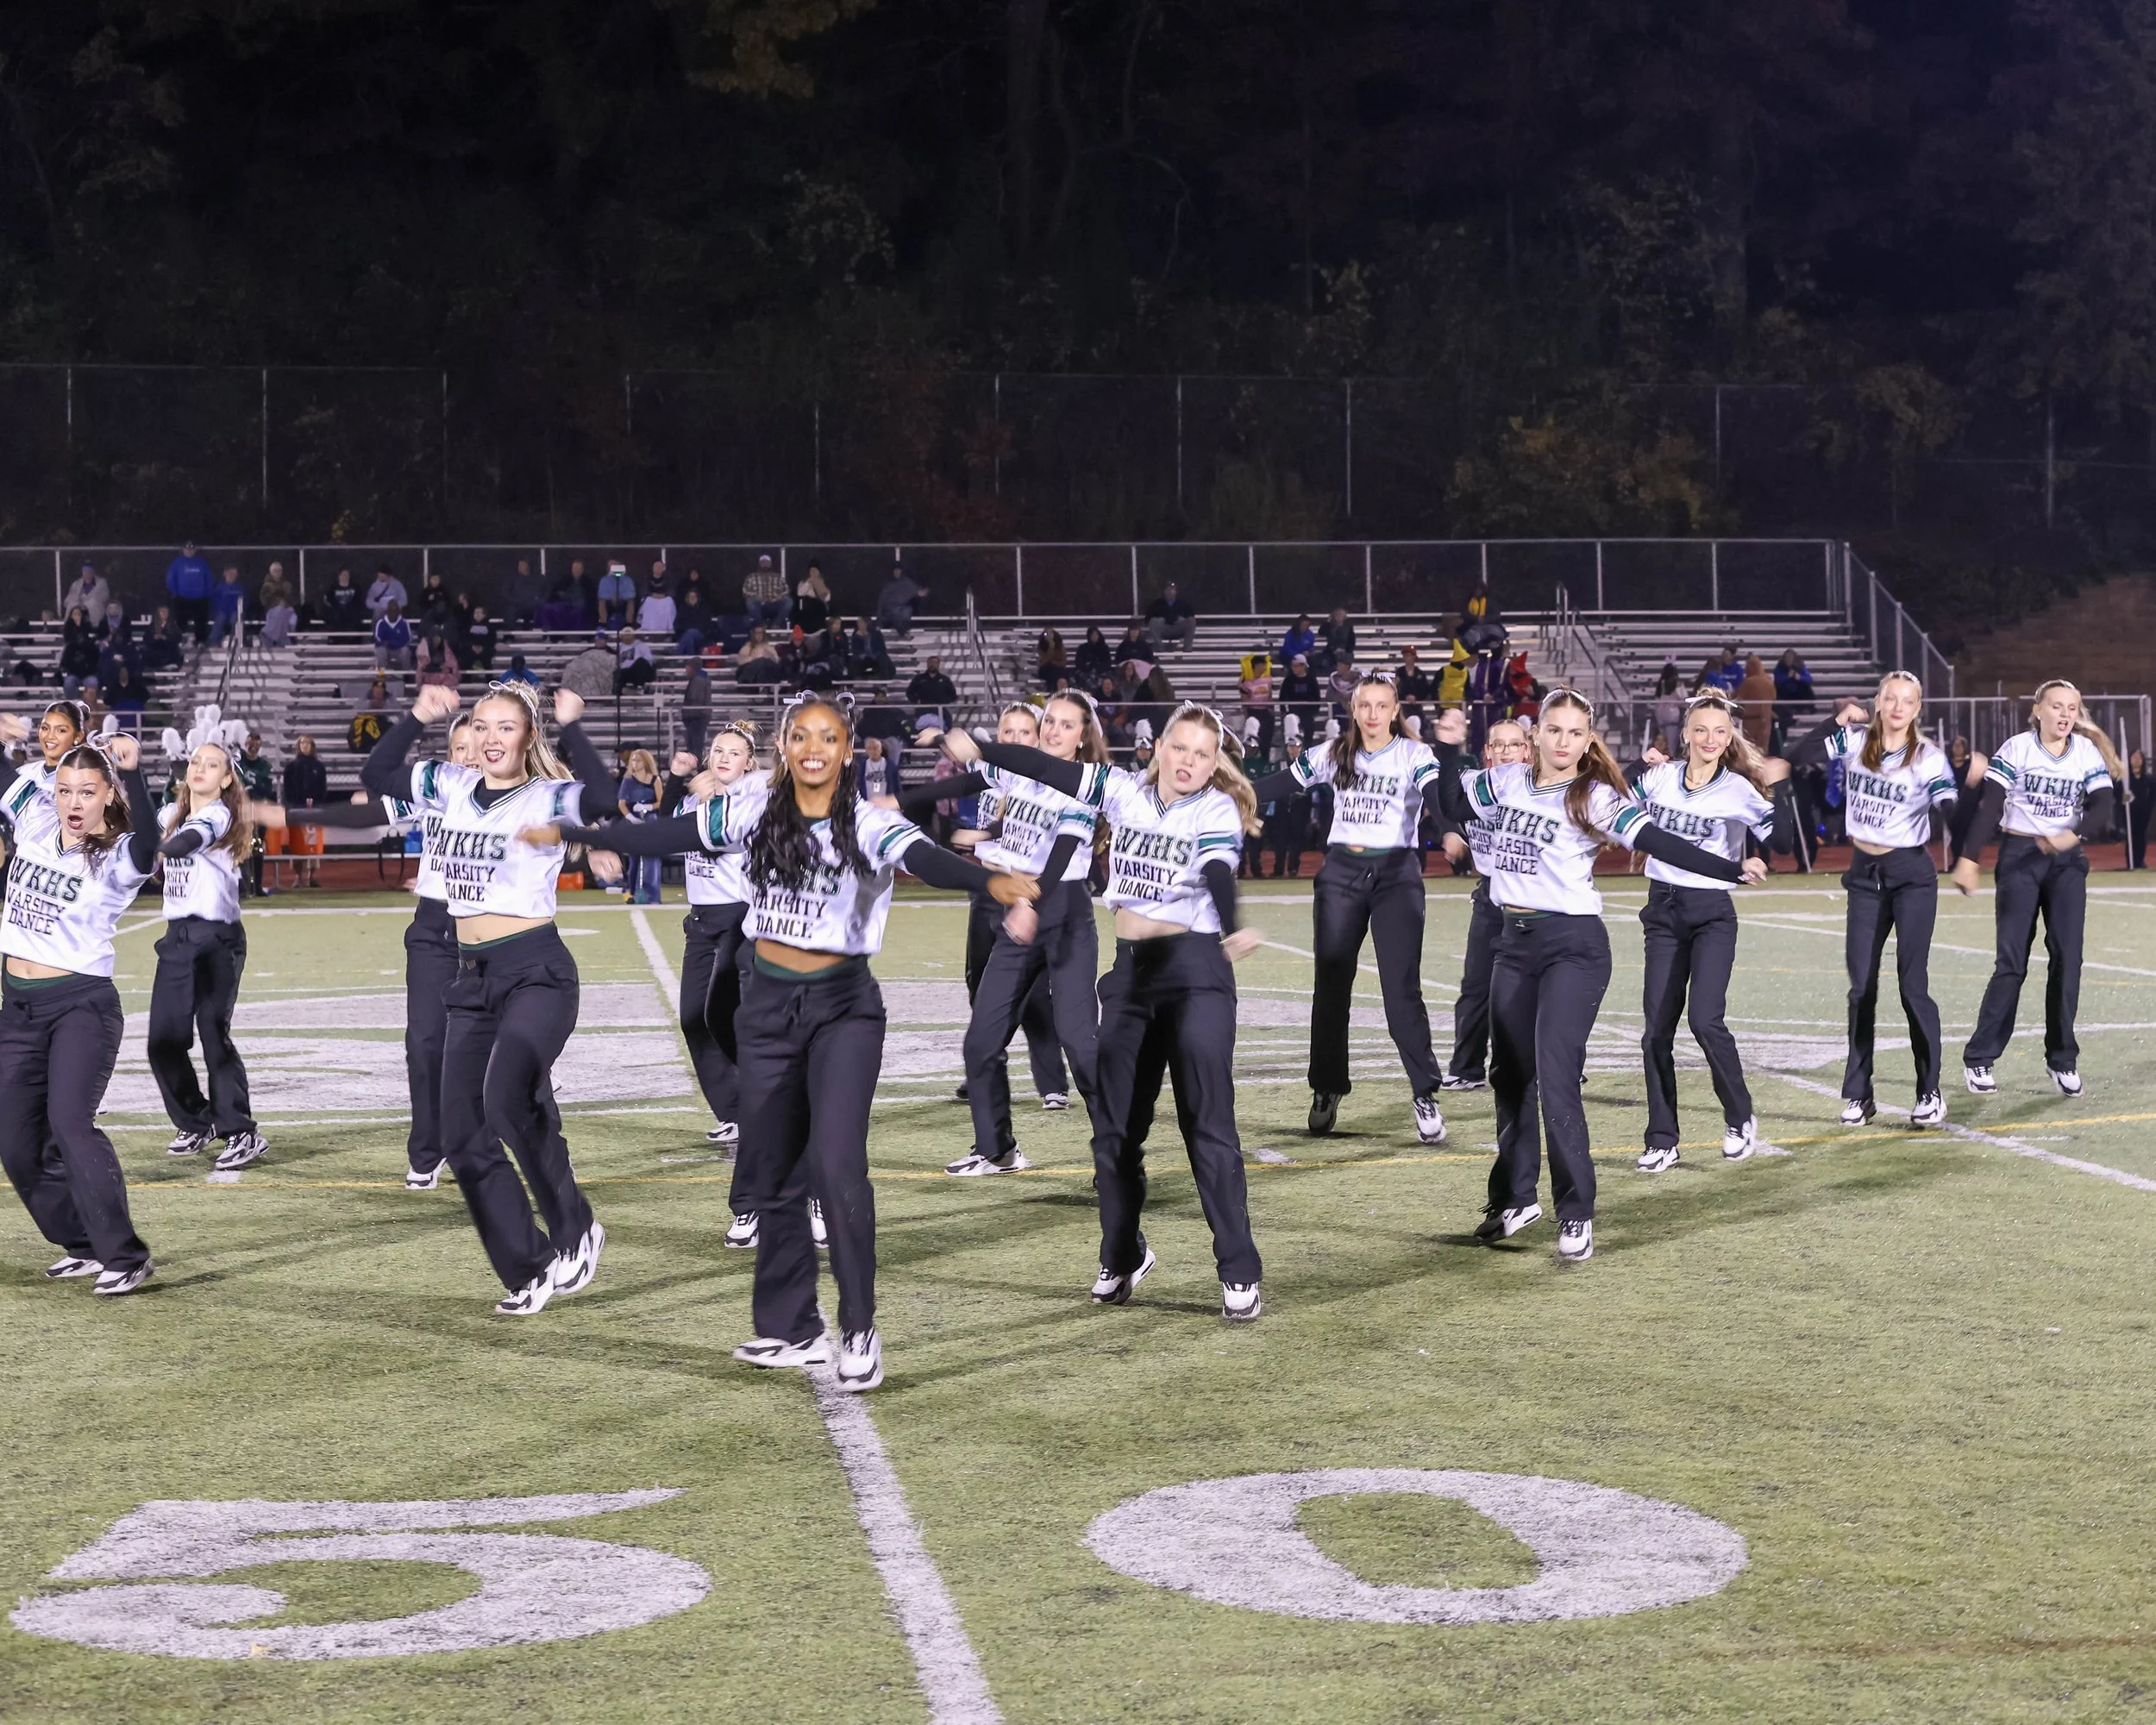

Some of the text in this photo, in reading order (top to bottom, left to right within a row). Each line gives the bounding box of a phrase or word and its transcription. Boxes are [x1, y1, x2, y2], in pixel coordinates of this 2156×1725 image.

[1848, 770, 1908, 804] WKHS
[2024, 774, 2084, 798] WKHS
[1850, 794, 1896, 816] VARSITY
[2033, 805, 2071, 818] DANCE
[1342, 811, 1382, 825] DANCE
[1113, 825, 1193, 868] WKHS
[445, 862, 496, 883] ARSITY
[1114, 856, 1178, 886] VARSITY
[1495, 853, 1539, 875] DANCE
[9, 856, 85, 904] WKHS
[1117, 878, 1164, 903] DANCE
[7, 886, 66, 920] VARSITY
[8, 907, 54, 936] DANCE
[756, 914, 814, 938] DANCE
